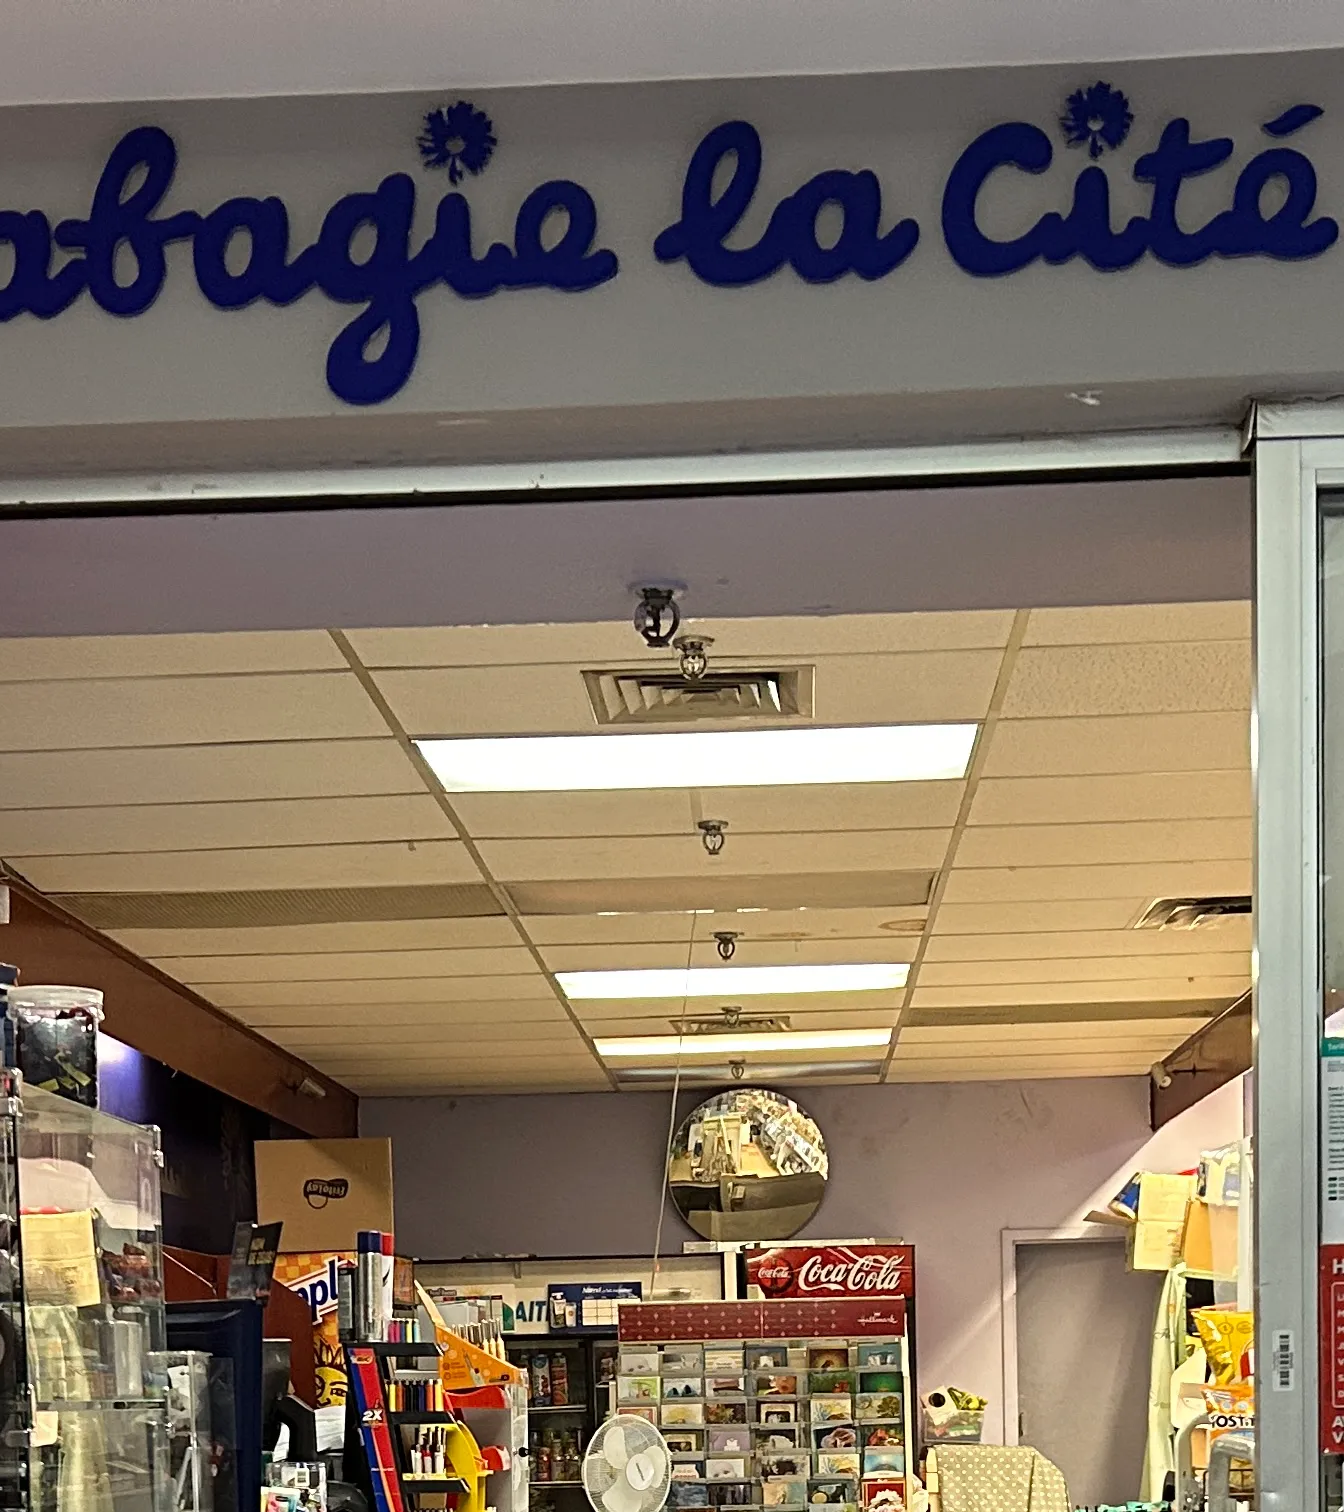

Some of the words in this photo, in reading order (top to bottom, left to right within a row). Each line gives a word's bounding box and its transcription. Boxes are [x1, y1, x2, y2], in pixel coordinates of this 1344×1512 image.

[655, 120, 918, 289] la
[942, 80, 1339, 270] Cité
[798, 1254, 903, 1293] Coca-Cola
[362, 1410, 383, 1421] 2X
